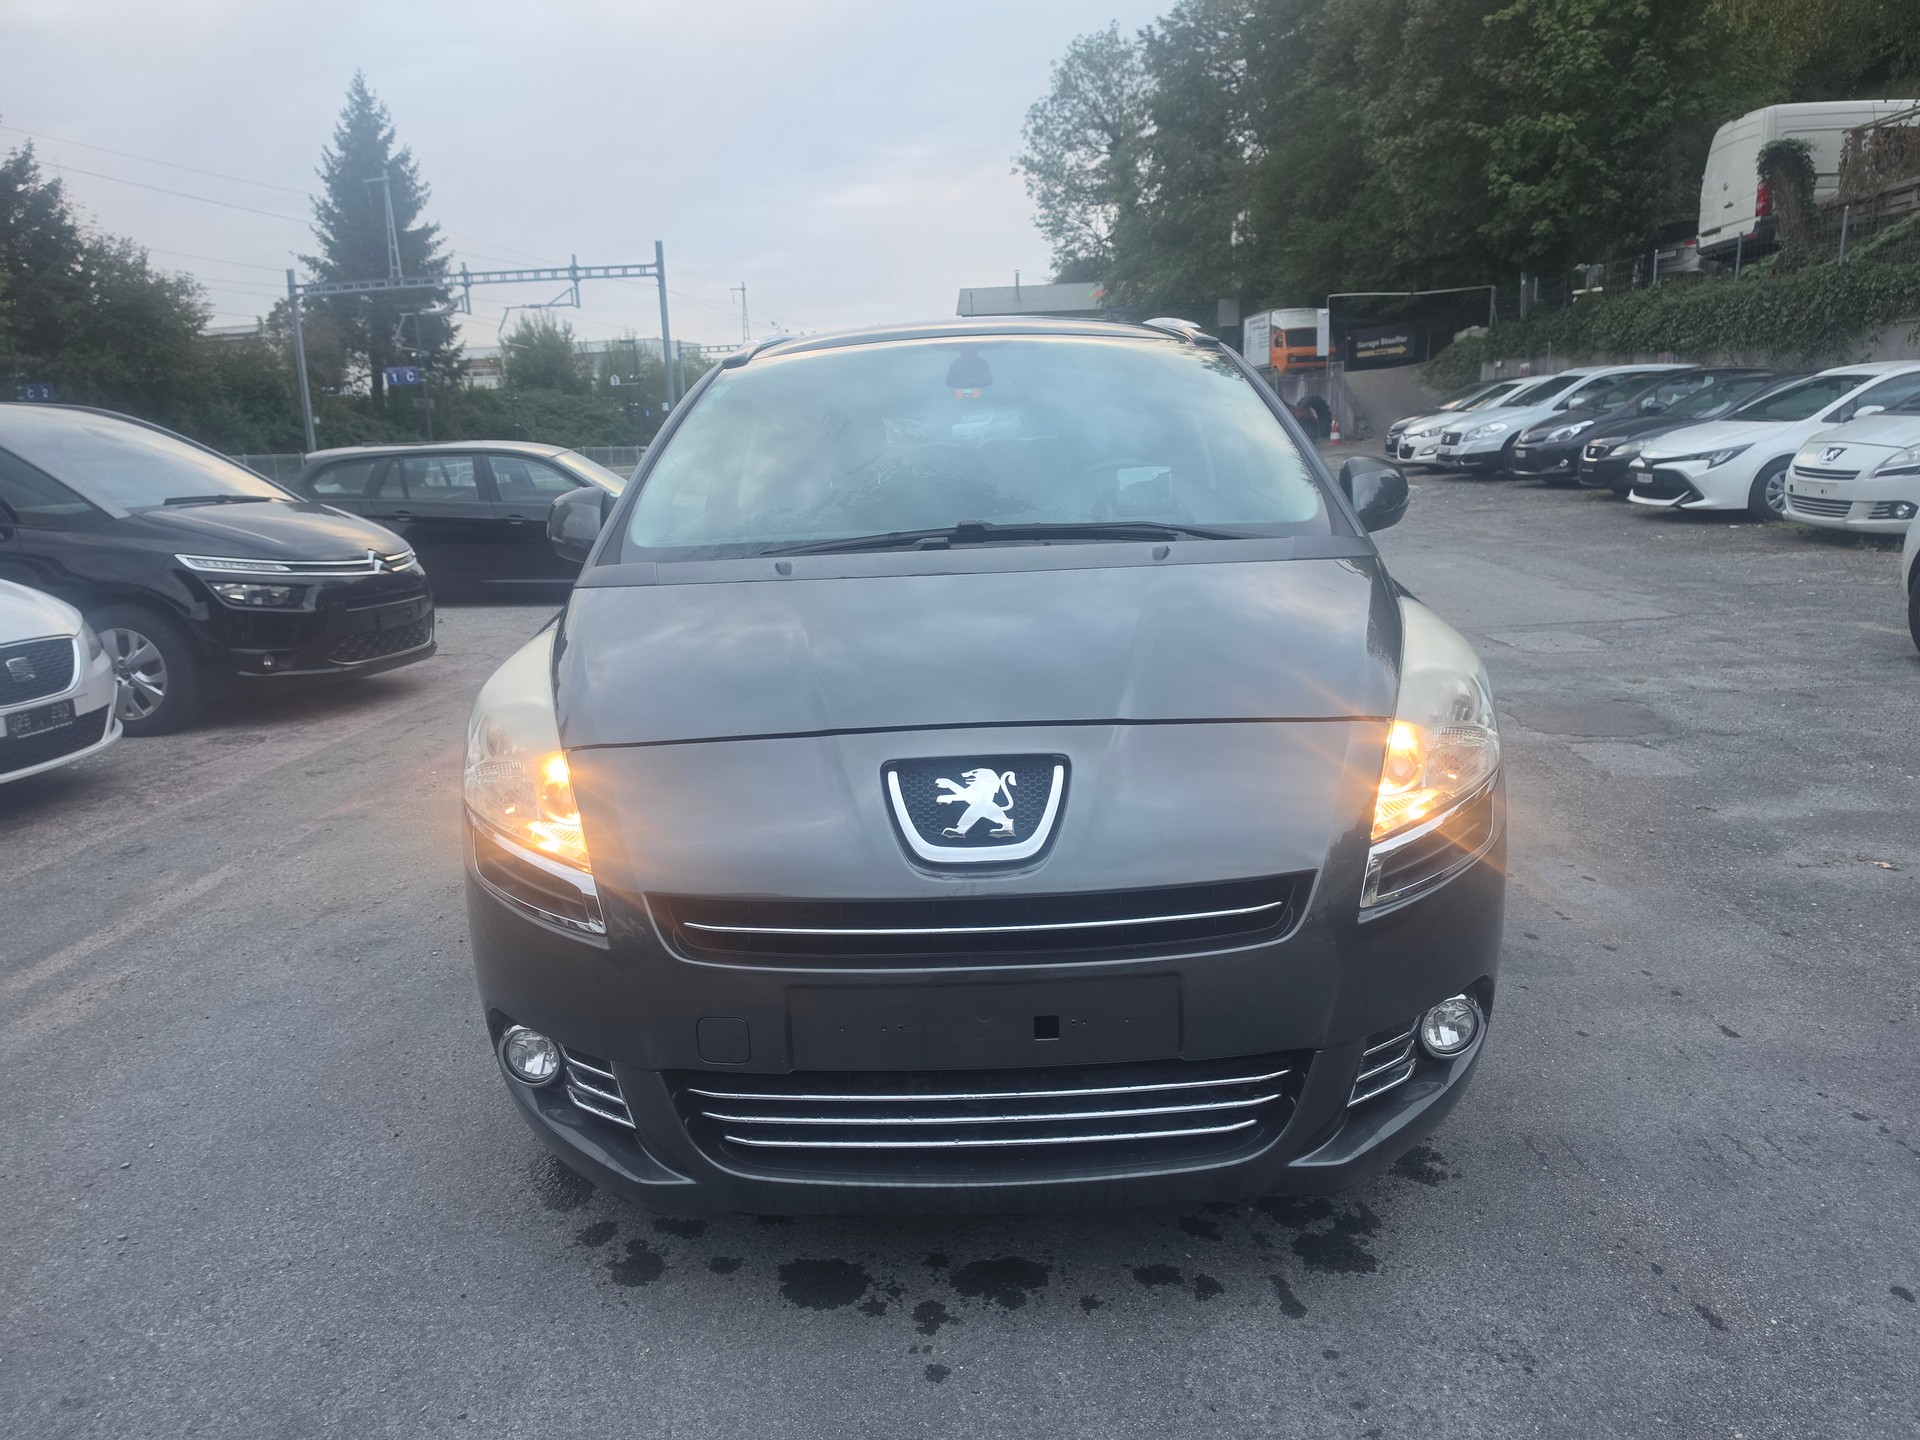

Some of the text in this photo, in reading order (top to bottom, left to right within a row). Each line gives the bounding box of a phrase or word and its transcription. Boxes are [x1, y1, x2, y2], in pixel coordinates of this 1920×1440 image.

[1357, 340, 1380, 348] Garage
[391, 371, 415, 382] 1 C
[27, 387, 49, 399] C 2
